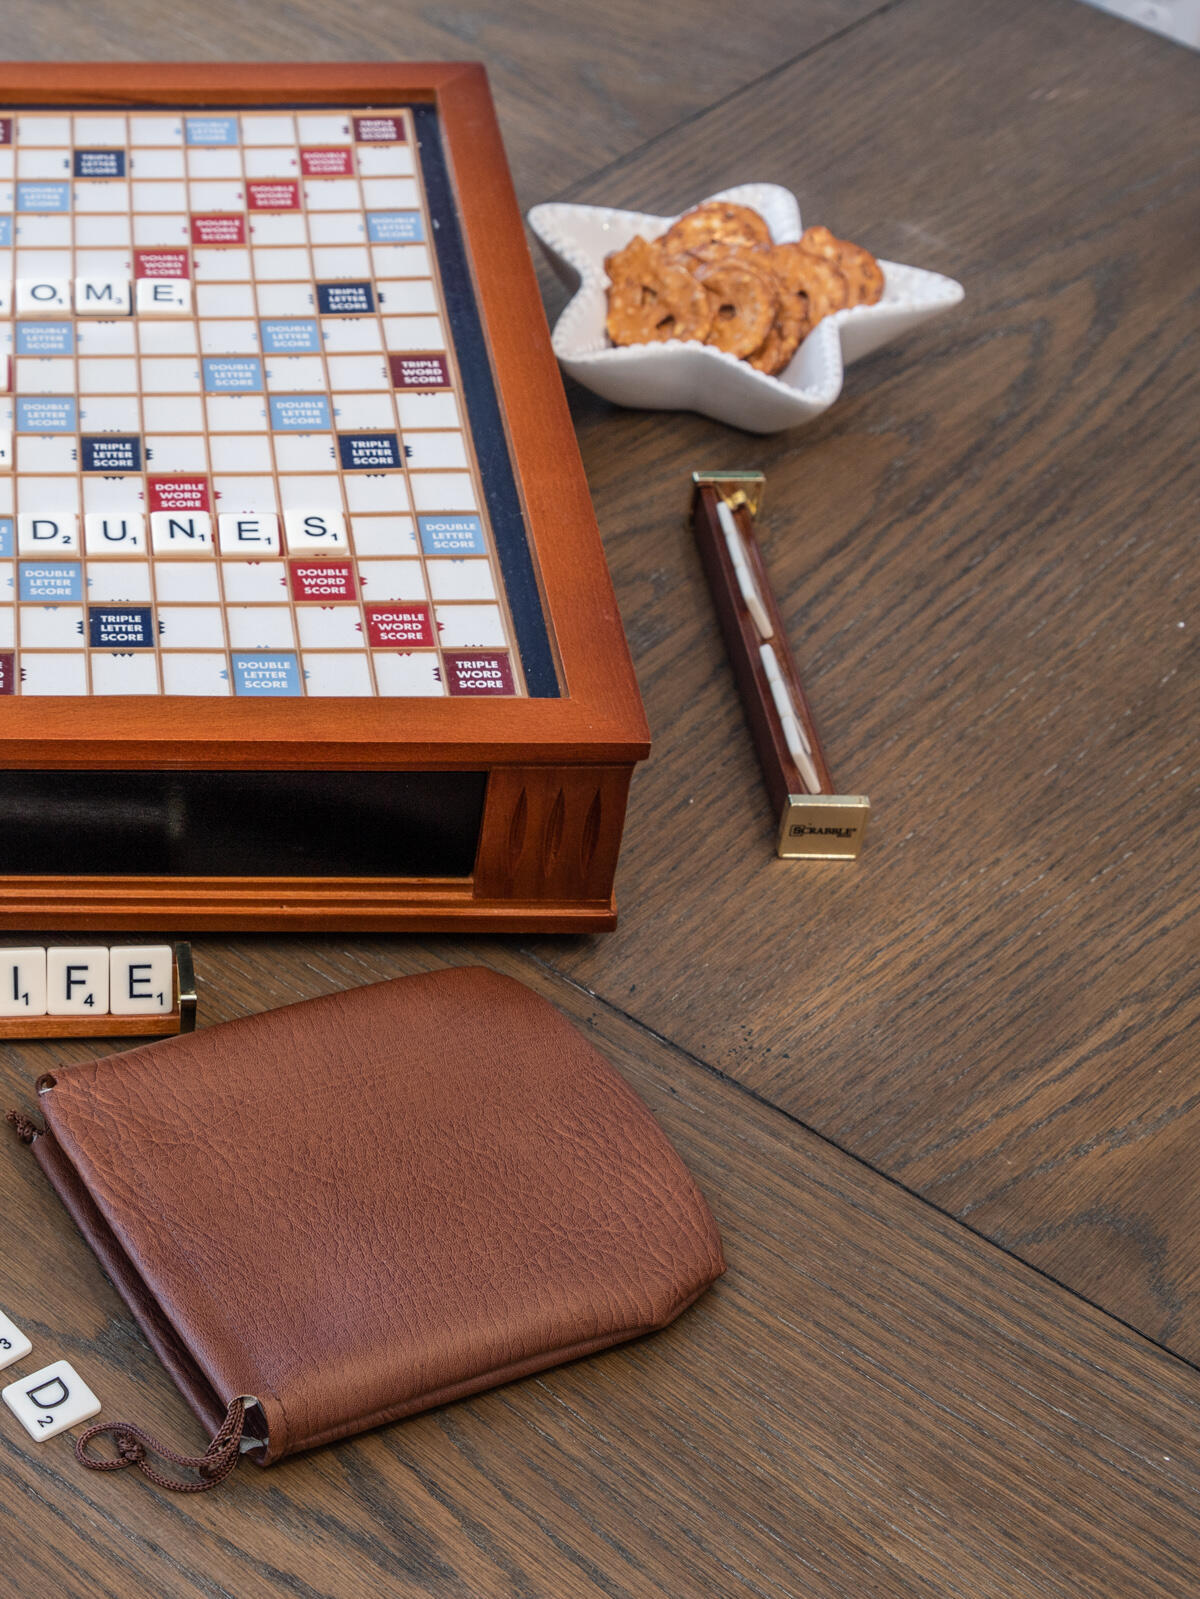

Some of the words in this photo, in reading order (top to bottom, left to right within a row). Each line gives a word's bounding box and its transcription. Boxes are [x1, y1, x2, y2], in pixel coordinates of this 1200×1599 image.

[93, 442, 131, 450] TRIPLE
[351, 448, 392, 456] LETTER
[93, 459, 133, 467] SCORE
[155, 483, 204, 491] DOUBLE
[159, 491, 201, 499] WORD
[161, 500, 201, 508] SCORE
[32, 516, 328, 542] DUNES
[426, 522, 476, 530] DOUBLE
[431, 531, 473, 539] LETTER
[433, 541, 475, 549] SCORE
[25, 569, 75, 577] DOUBLE
[296, 568, 348, 576] DOUBLE
[30, 578, 70, 586] LETTER
[302, 577, 346, 585] WORD
[30, 587, 71, 595] SCORE
[304, 587, 346, 595] SCORE
[100, 614, 141, 622] TRIPLE
[372, 612, 424, 620] DOUBLE
[101, 624, 142, 632] LETTER
[378, 622, 421, 631] WORD
[100, 633, 143, 642] SCORE
[380, 633, 423, 641] SCORE
[238, 661, 290, 669] DOUBLE
[455, 659, 499, 668] TRIPLE
[244, 670, 286, 679] LETTER
[456, 670, 502, 678] WORD
[245, 679, 288, 688] SCORE
[458, 680, 503, 689] SCORE
